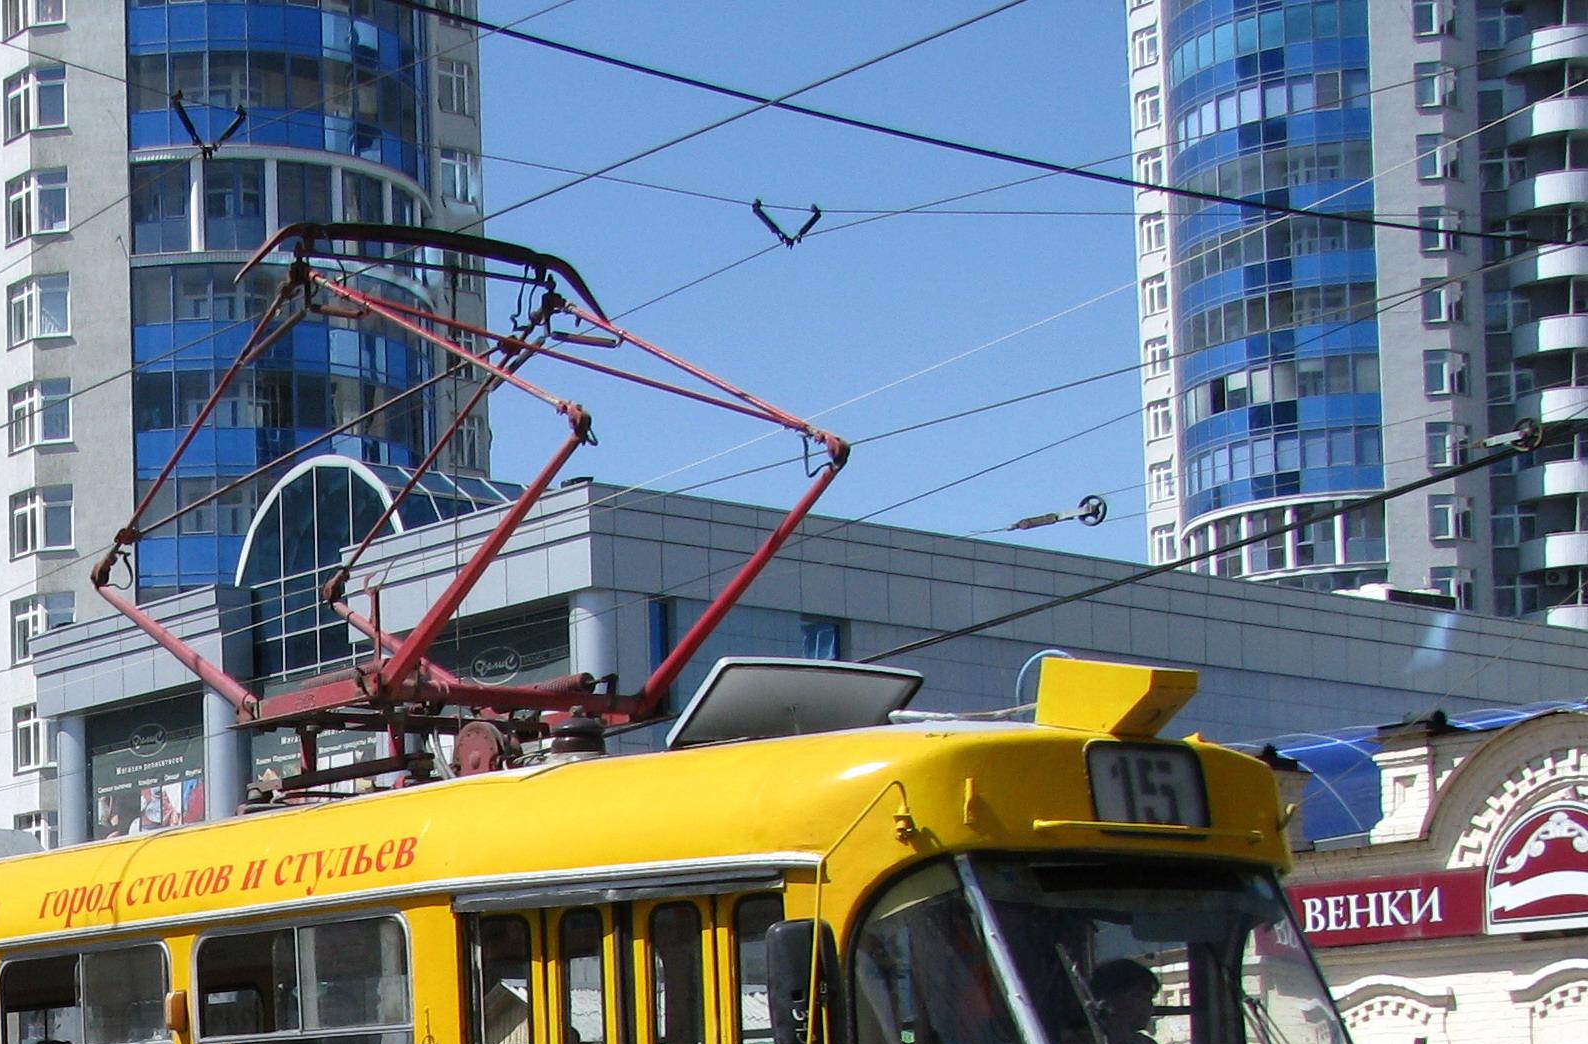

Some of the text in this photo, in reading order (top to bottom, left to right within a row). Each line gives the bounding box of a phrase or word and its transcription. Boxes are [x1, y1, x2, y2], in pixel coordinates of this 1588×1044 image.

[1111, 755, 1181, 824] 15
[38, 835, 419, 927] город столов и стульев
[1302, 886, 1444, 934] ВЕНКИ
